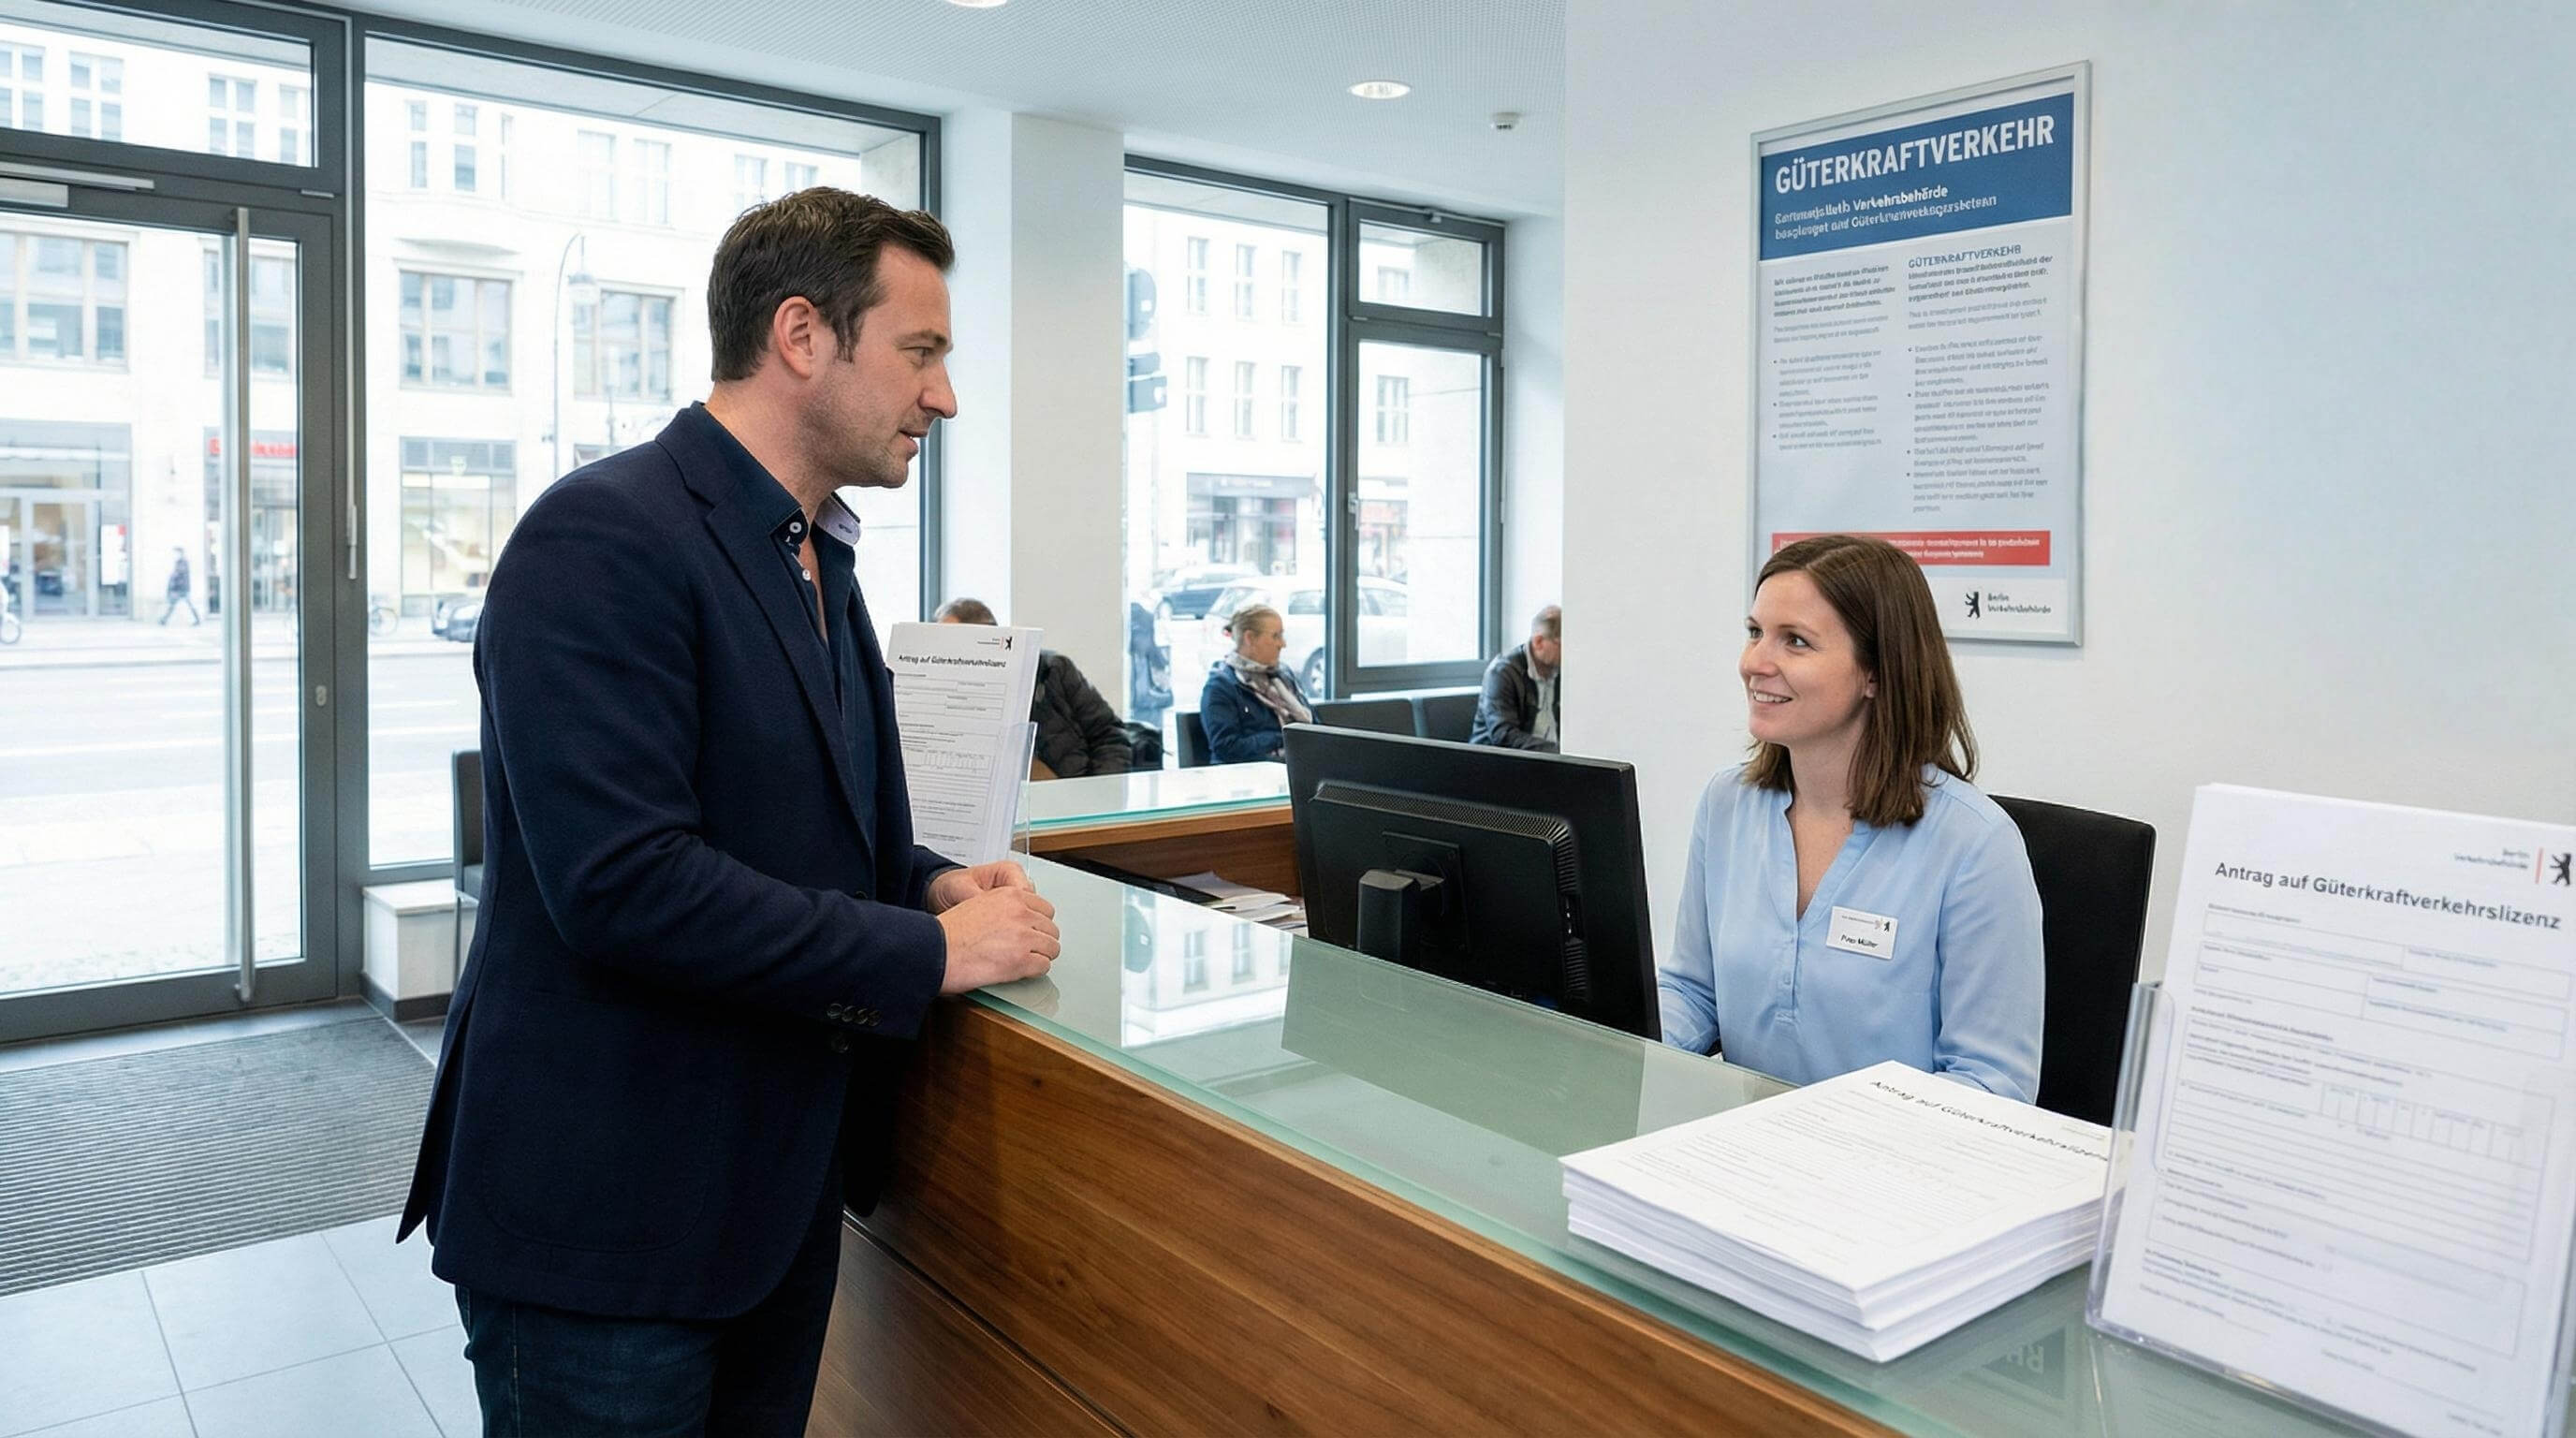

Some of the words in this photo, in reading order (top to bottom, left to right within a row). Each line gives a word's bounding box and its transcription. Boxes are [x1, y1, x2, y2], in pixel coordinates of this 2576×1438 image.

[1775, 114, 2056, 195] GÜTERKRAFTVERKEHR
[2215, 861, 2275, 888] Antrag
[2278, 873, 2310, 891] auf
[2312, 876, 2562, 932] Güterkraftverkehrslizenz
[1869, 1080, 1915, 1101] Antrag
